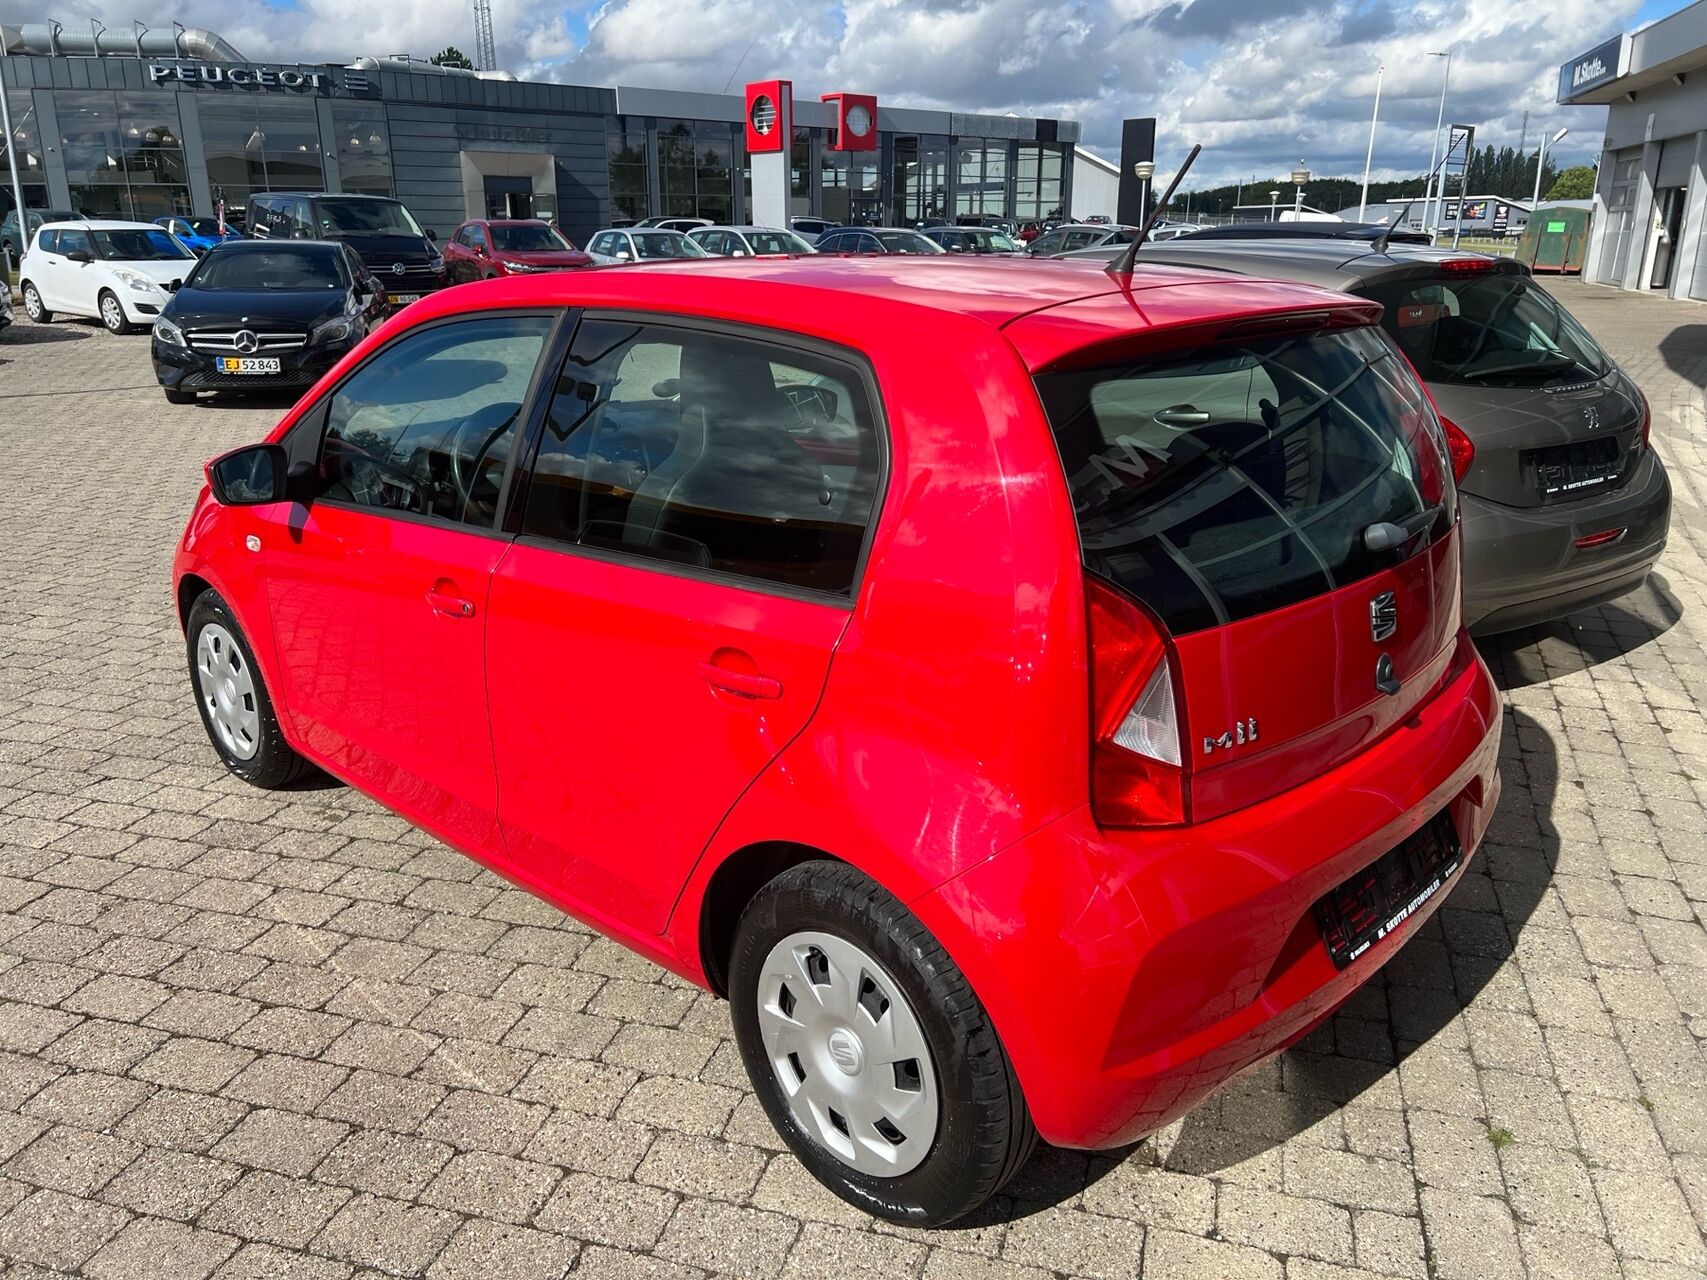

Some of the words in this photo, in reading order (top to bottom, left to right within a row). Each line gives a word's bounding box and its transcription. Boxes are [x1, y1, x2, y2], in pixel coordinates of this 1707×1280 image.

[149, 64, 325, 87] PEUGEOT
[225, 360, 240, 370] EJ
[242, 360, 256, 370] 52
[258, 360, 279, 370] 843
[1203, 716, 1258, 755] Mii
[1377, 927, 1387, 939] M.
[1386, 907, 1409, 932] SKOTTE
[1407, 879, 1440, 914] AUTOMOBILER
